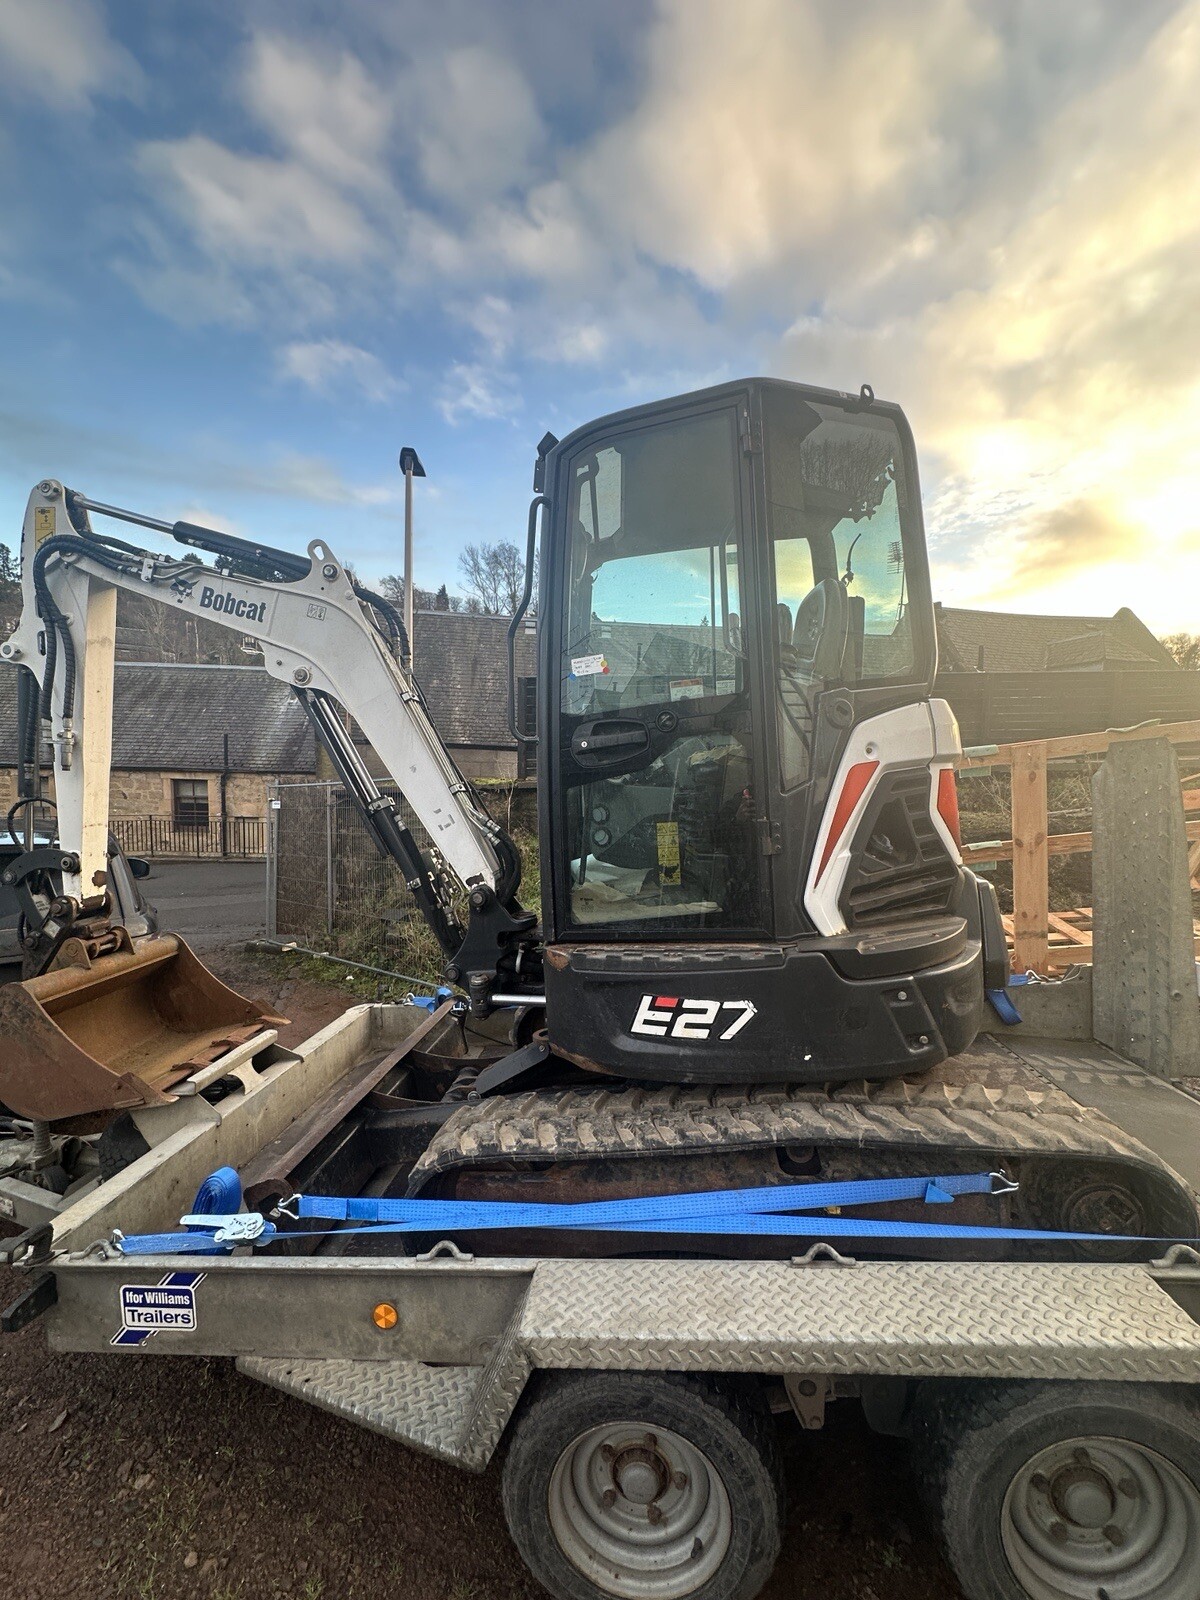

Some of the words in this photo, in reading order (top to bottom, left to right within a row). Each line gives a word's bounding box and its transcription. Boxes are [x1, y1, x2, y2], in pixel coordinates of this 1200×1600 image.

[199, 586, 267, 622] Bobcat
[631, 996, 758, 1040] E27
[125, 1291, 143, 1304] Ifor
[144, 1292, 190, 1305] Williams
[127, 1309, 191, 1325] Trailers
